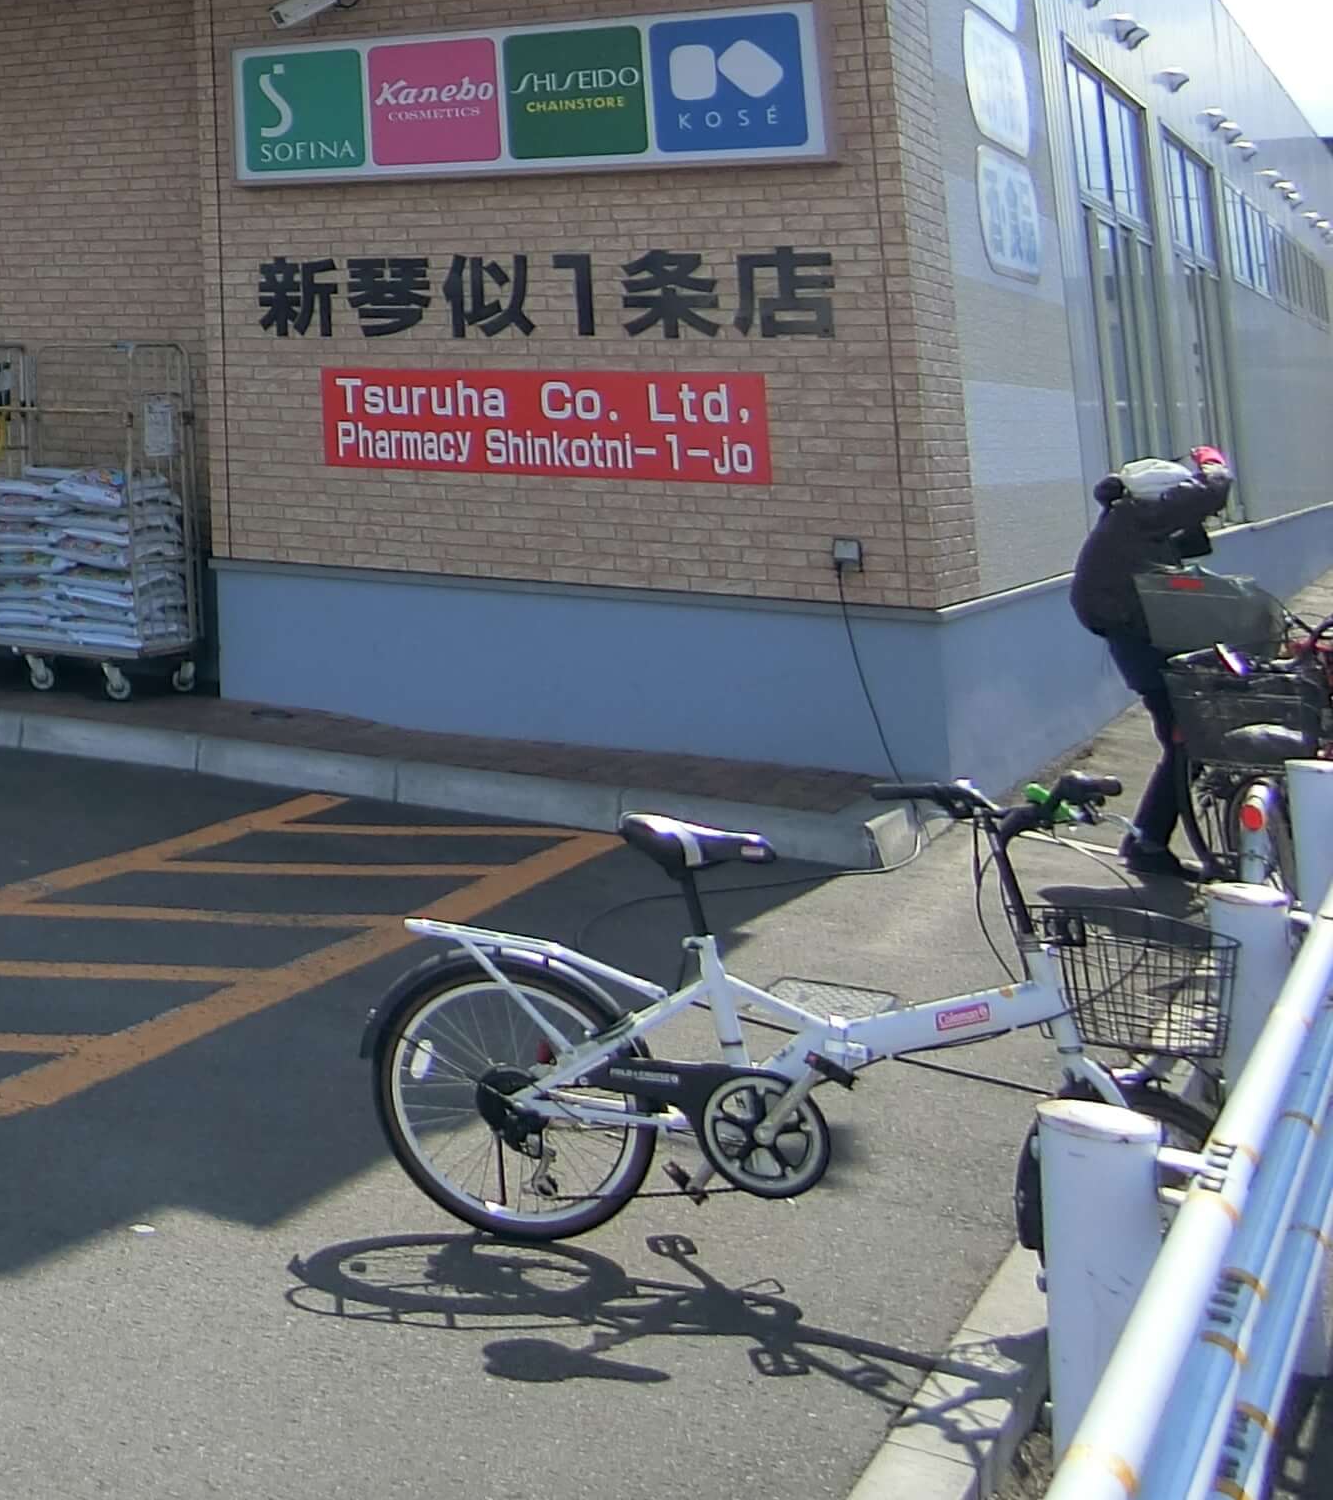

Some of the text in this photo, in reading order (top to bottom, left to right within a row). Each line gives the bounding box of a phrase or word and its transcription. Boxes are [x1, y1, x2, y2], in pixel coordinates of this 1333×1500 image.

[374, 77, 495, 108] Kanebo
[509, 65, 640, 95] SHISEIDO
[387, 105, 481, 123] COSMETICS
[525, 96, 626, 114] CHAINSTORE
[677, 105, 780, 131] KOSÉ
[259, 138, 356, 164] SOFINA
[258, 246, 835, 340] 新琴似1条店
[335, 377, 506, 419] Tsuruha
[539, 381, 619, 422] Co.
[336, 421, 754, 475] Pharmacy Shinkotni-1-jo
